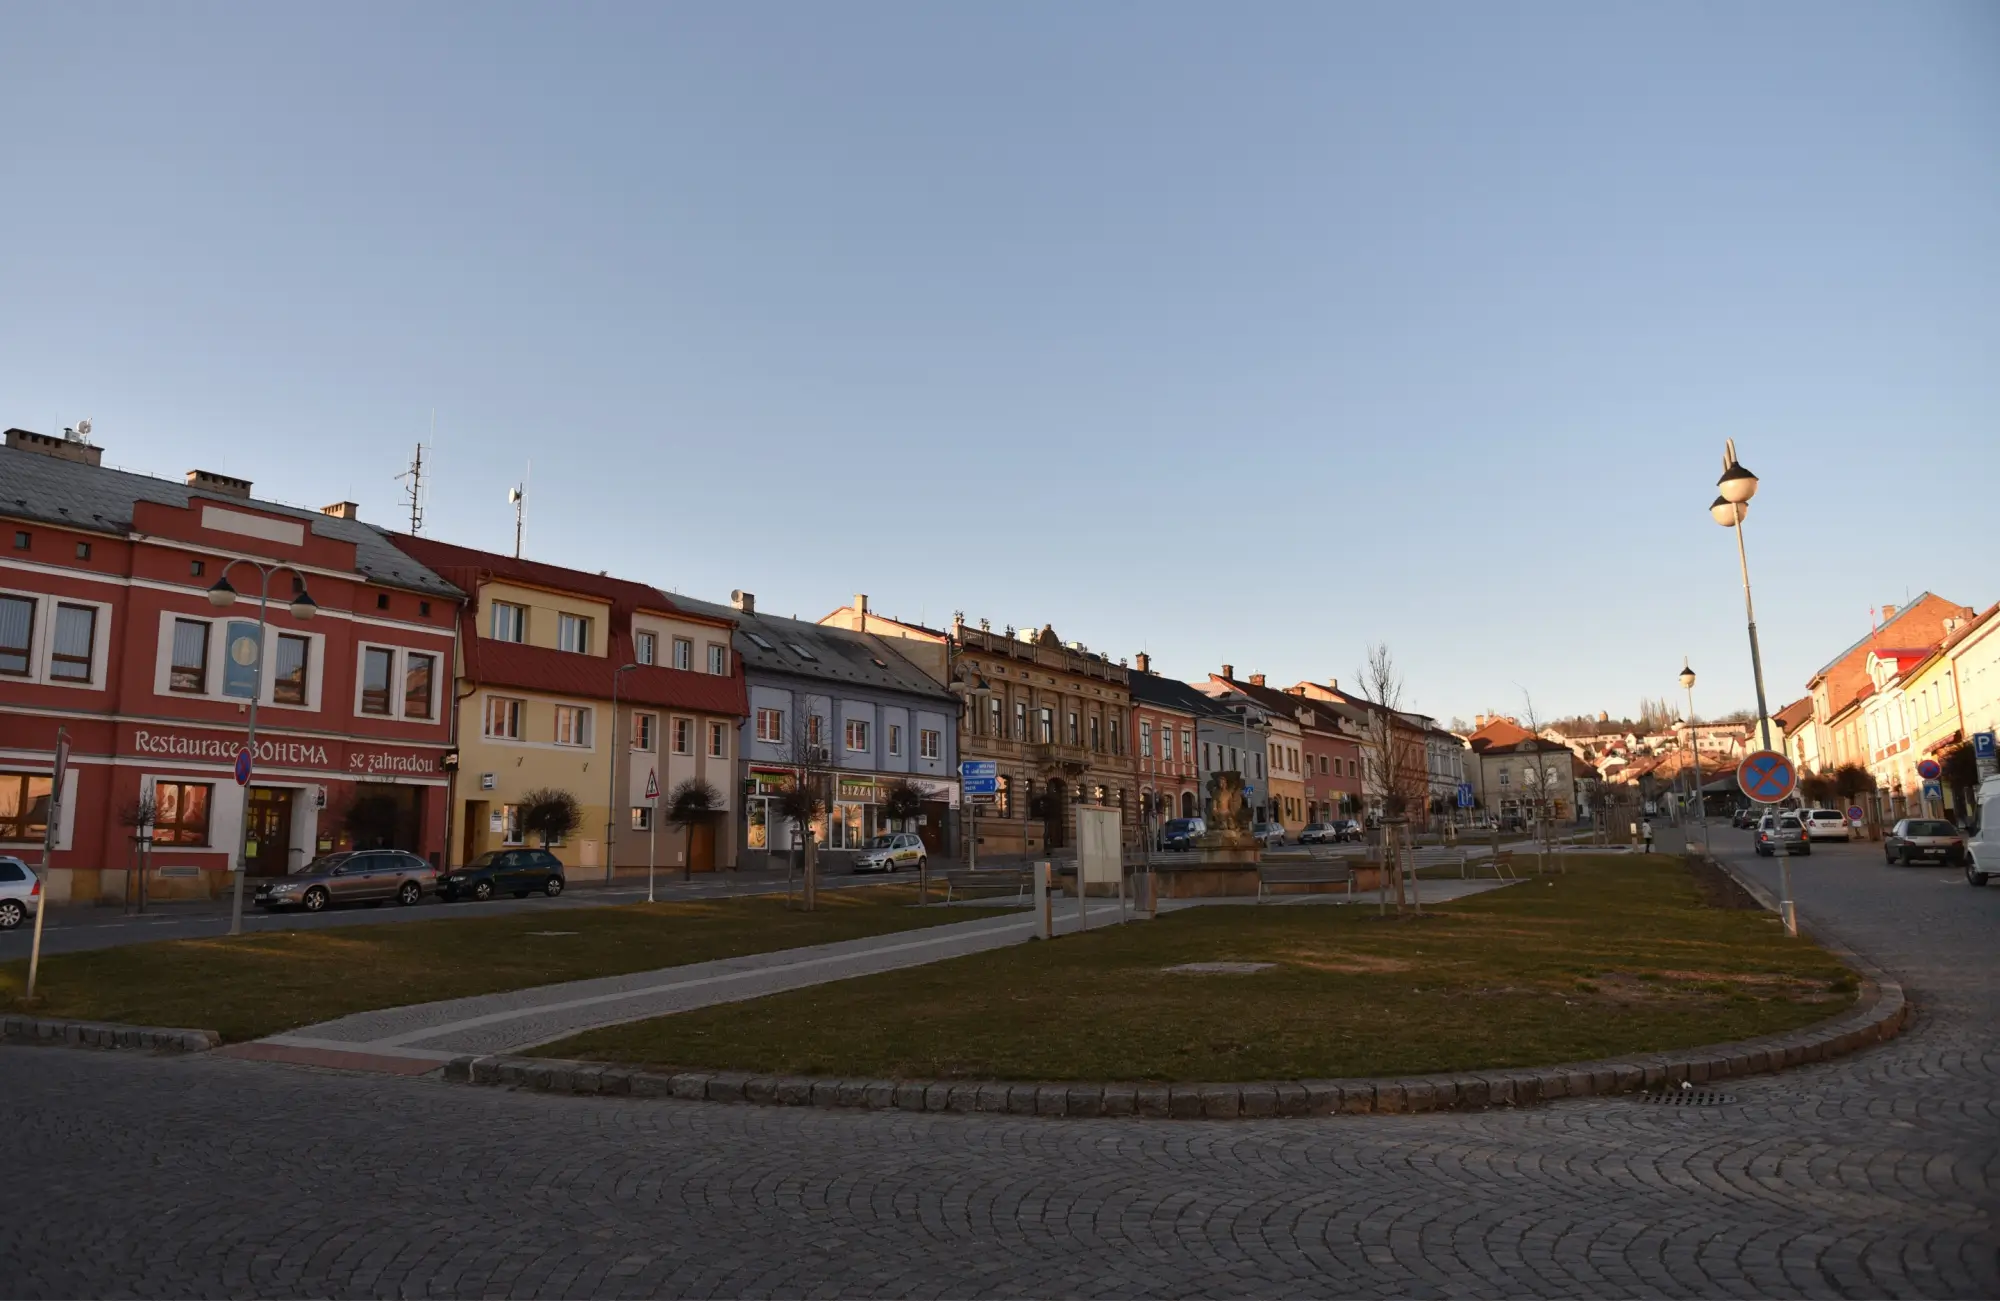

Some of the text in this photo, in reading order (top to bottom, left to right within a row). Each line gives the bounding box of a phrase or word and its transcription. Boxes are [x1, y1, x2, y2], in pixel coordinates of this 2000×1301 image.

[1978, 735, 1990, 751] P
[135, 730, 239, 759] Restaurace
[349, 752, 364, 768] se
[367, 751, 434, 773] zahradou
[841, 784, 872, 797] PIZZA
